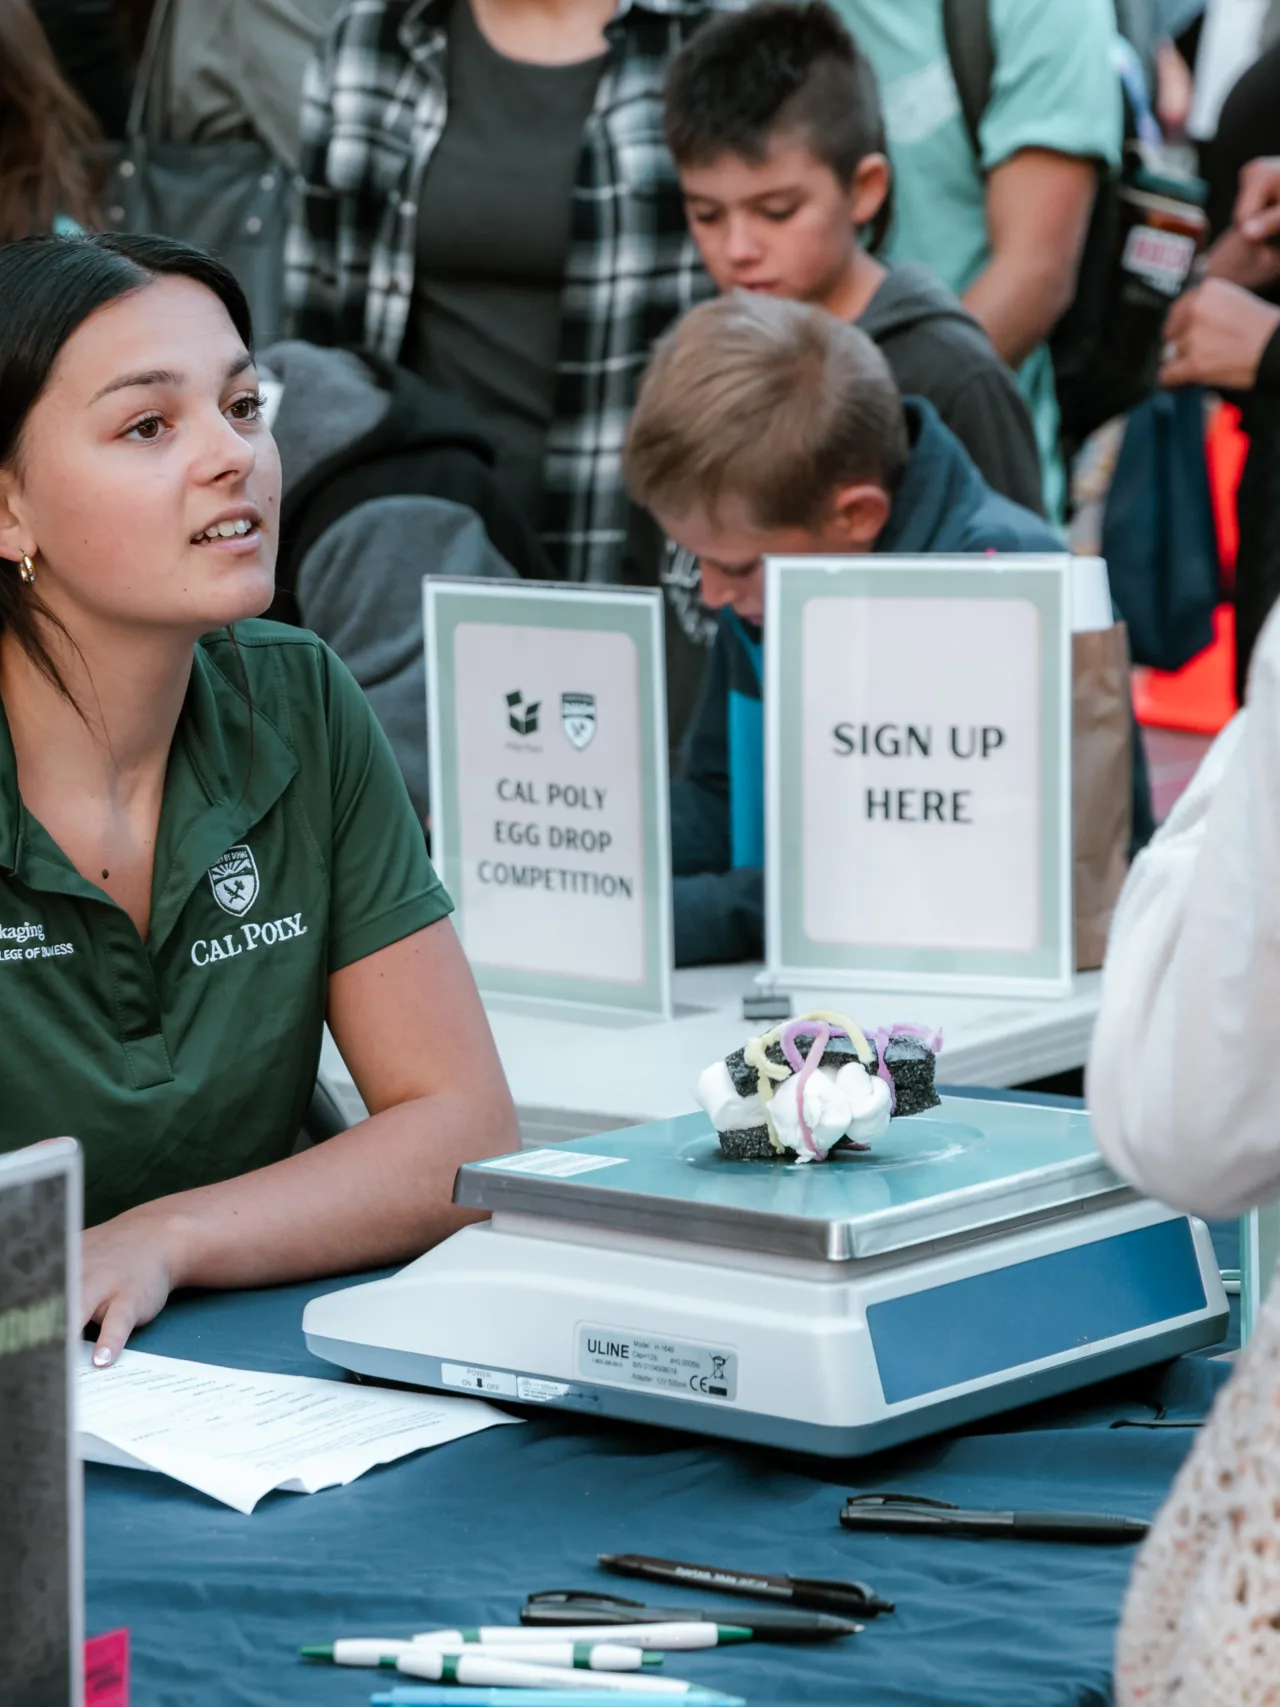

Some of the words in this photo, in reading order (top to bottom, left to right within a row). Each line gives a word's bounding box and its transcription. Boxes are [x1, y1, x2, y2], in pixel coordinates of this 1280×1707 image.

[832, 722, 932, 757] SIGN
[950, 725, 1006, 759] UP
[497, 777, 540, 805] CAL
[548, 783, 607, 811] POLY
[866, 788, 973, 824] HERE
[494, 820, 541, 846] EGG
[549, 826, 612, 852] DROP
[478, 860, 634, 898] COMPETITION
[25, 948, 41, 959] OF
[191, 934, 242, 966] CAL
[240, 913, 305, 950] POLY
[587, 1338, 629, 1359] ULINE
[462, 1379, 472, 1387] ON
[486, 1383, 501, 1391] OFF
[467, 1368, 491, 1378] POWER
